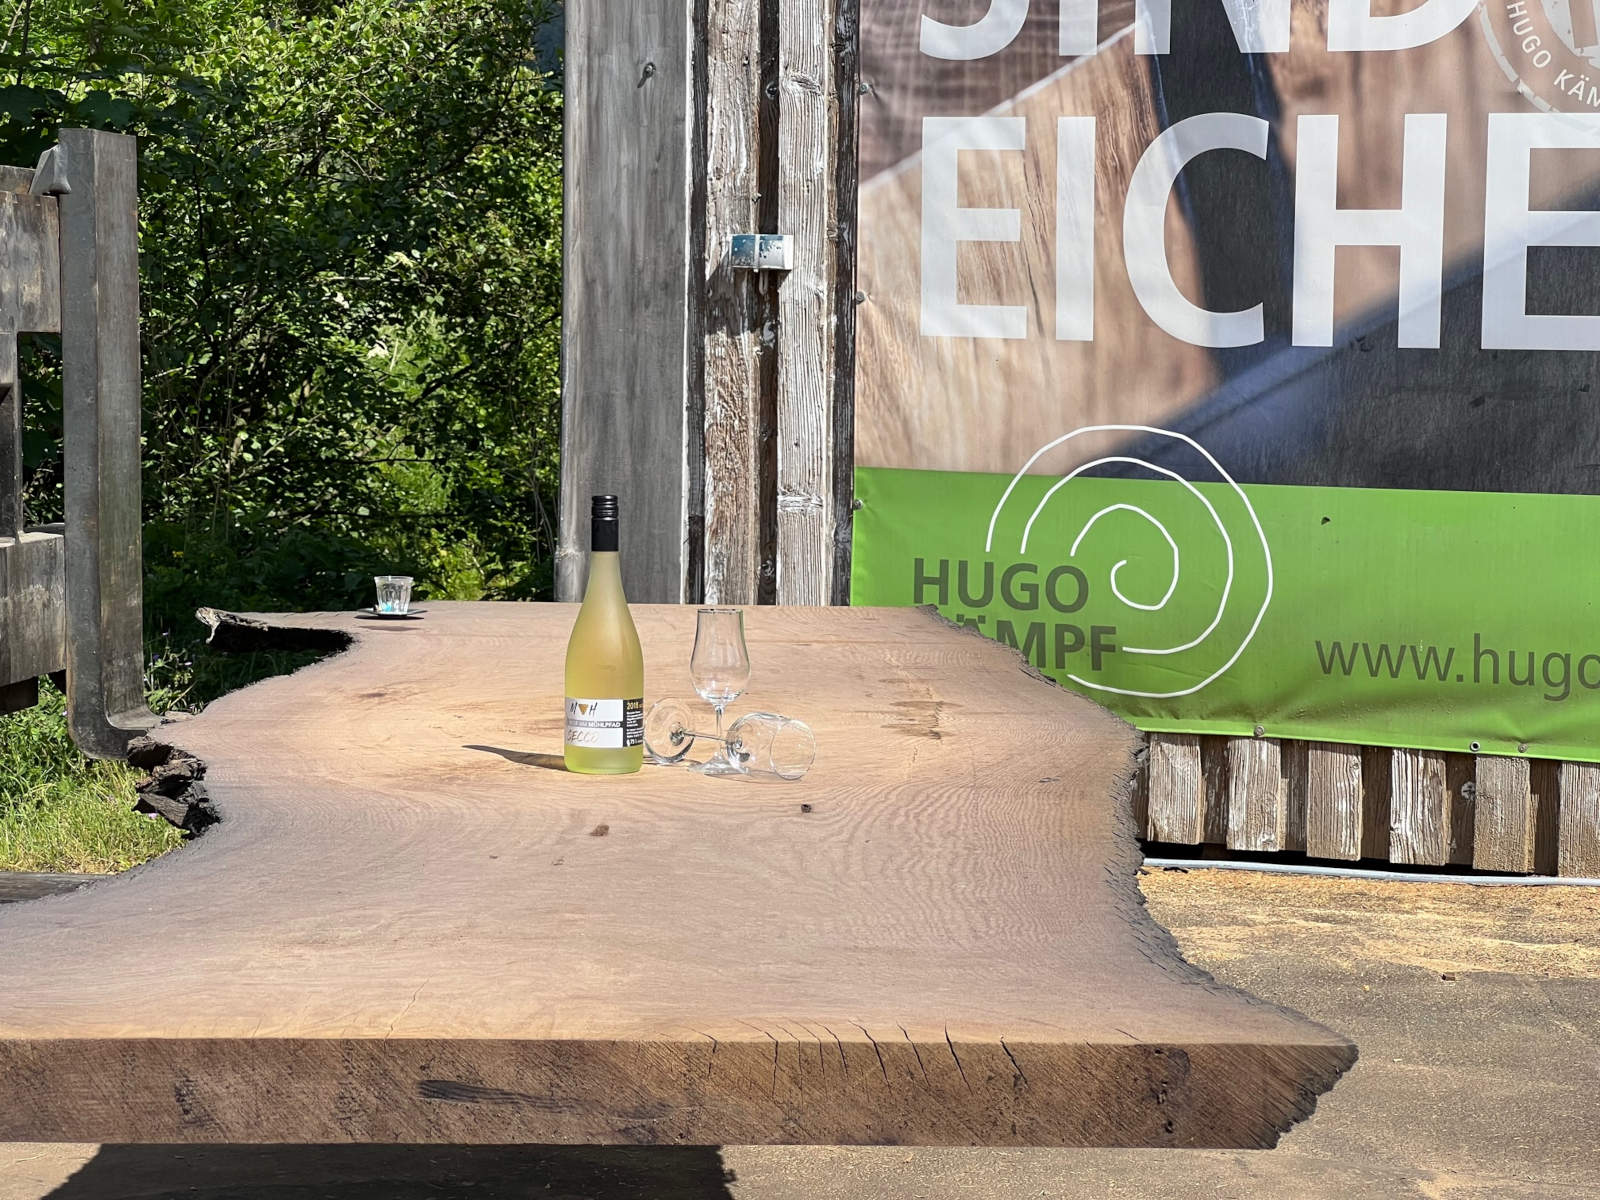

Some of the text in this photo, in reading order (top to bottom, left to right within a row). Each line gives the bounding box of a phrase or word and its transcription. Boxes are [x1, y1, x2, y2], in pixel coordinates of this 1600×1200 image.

[1506, 1, 1551, 68] HUGO
[919, 112, 1600, 350] EICHE
[913, 557, 1089, 613] HUGO
[956, 613, 1117, 671] MPF
[1315, 633, 1600, 701] www.hugo
